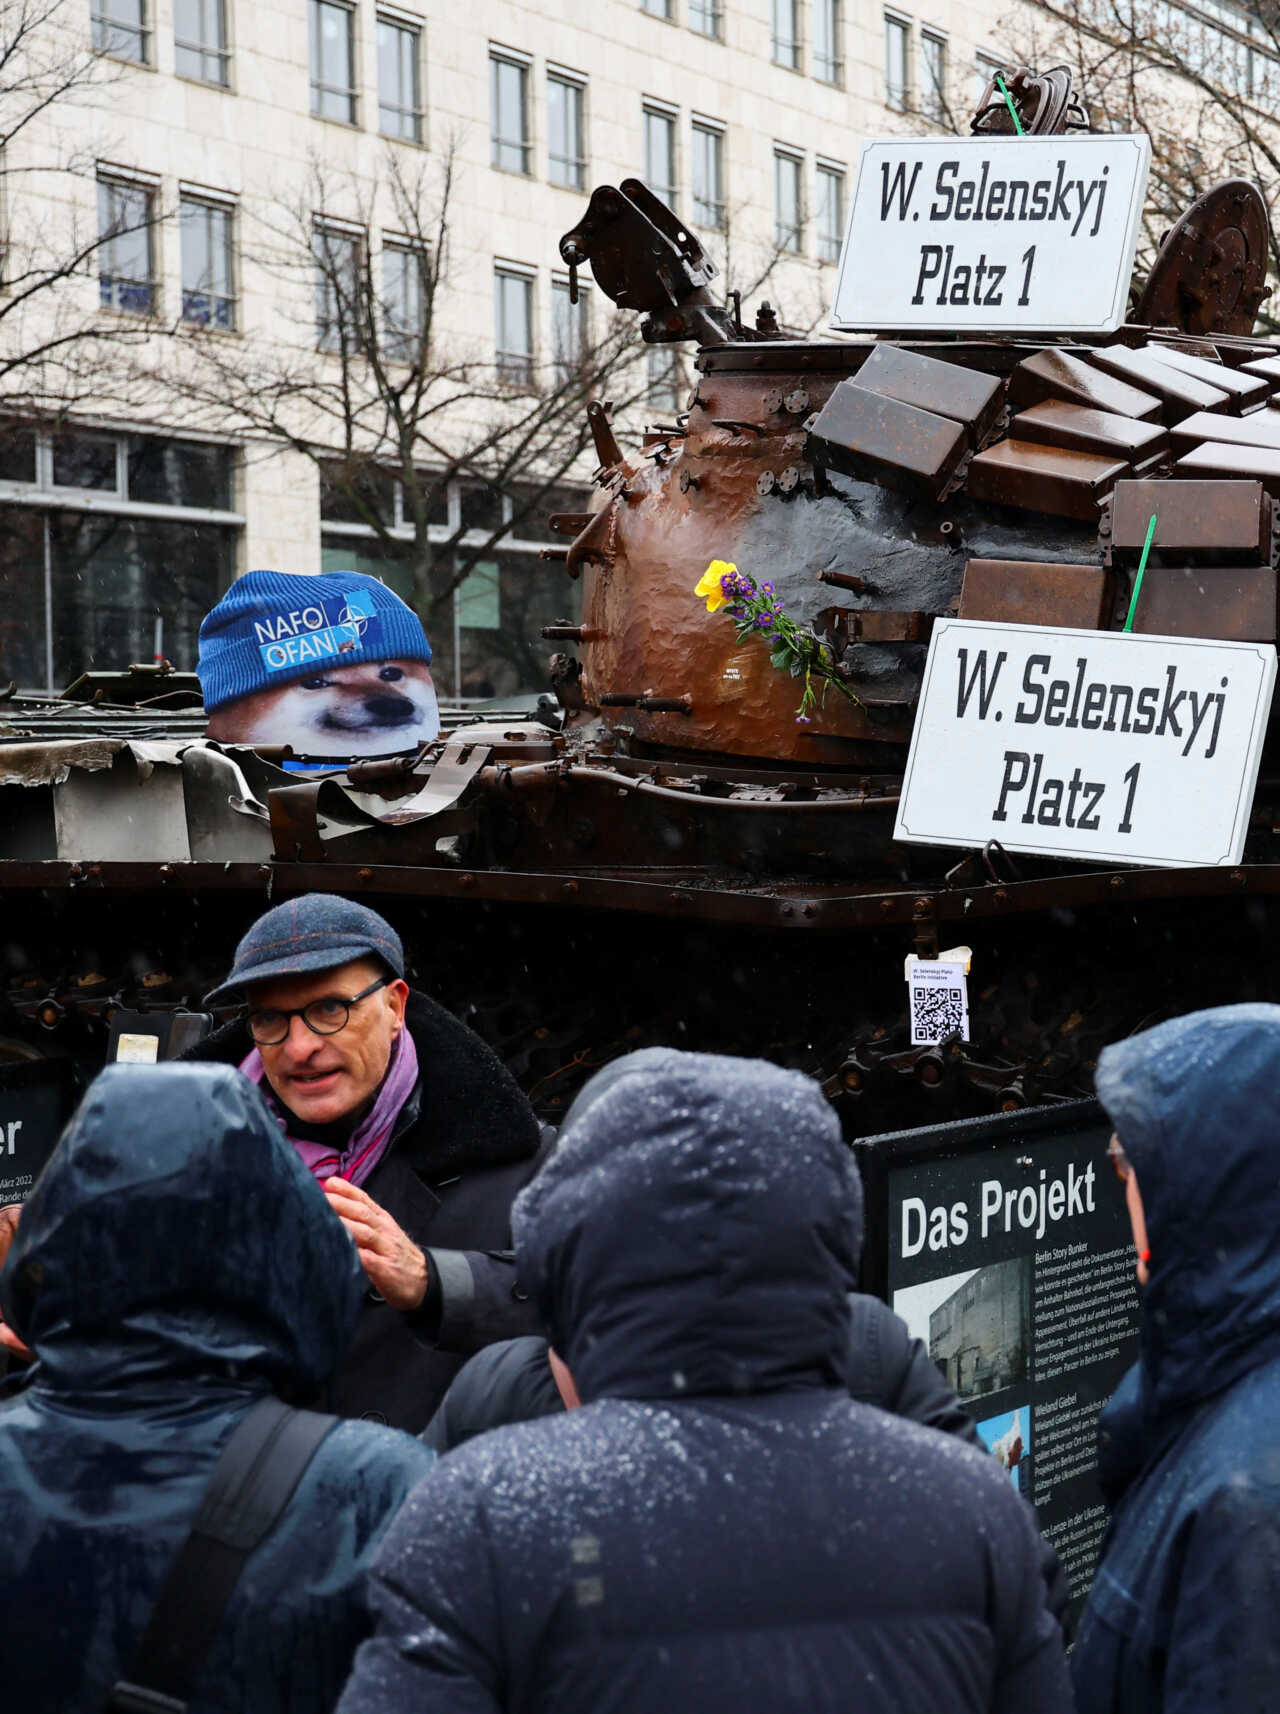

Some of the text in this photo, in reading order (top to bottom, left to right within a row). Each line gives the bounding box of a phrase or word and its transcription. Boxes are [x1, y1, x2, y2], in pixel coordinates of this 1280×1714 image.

[880, 159, 1109, 237] W. Selenskyj
[911, 244, 1037, 307] Platz 1
[254, 606, 324, 644] NAFO
[266, 631, 334, 668] OFAN
[955, 648, 1229, 759] W. Selenskyj
[992, 750, 1142, 834] Platz 1
[902, 1160, 1096, 1258] Das Projekt
[1035, 1242, 1088, 1264] Berlin Story Bunker
